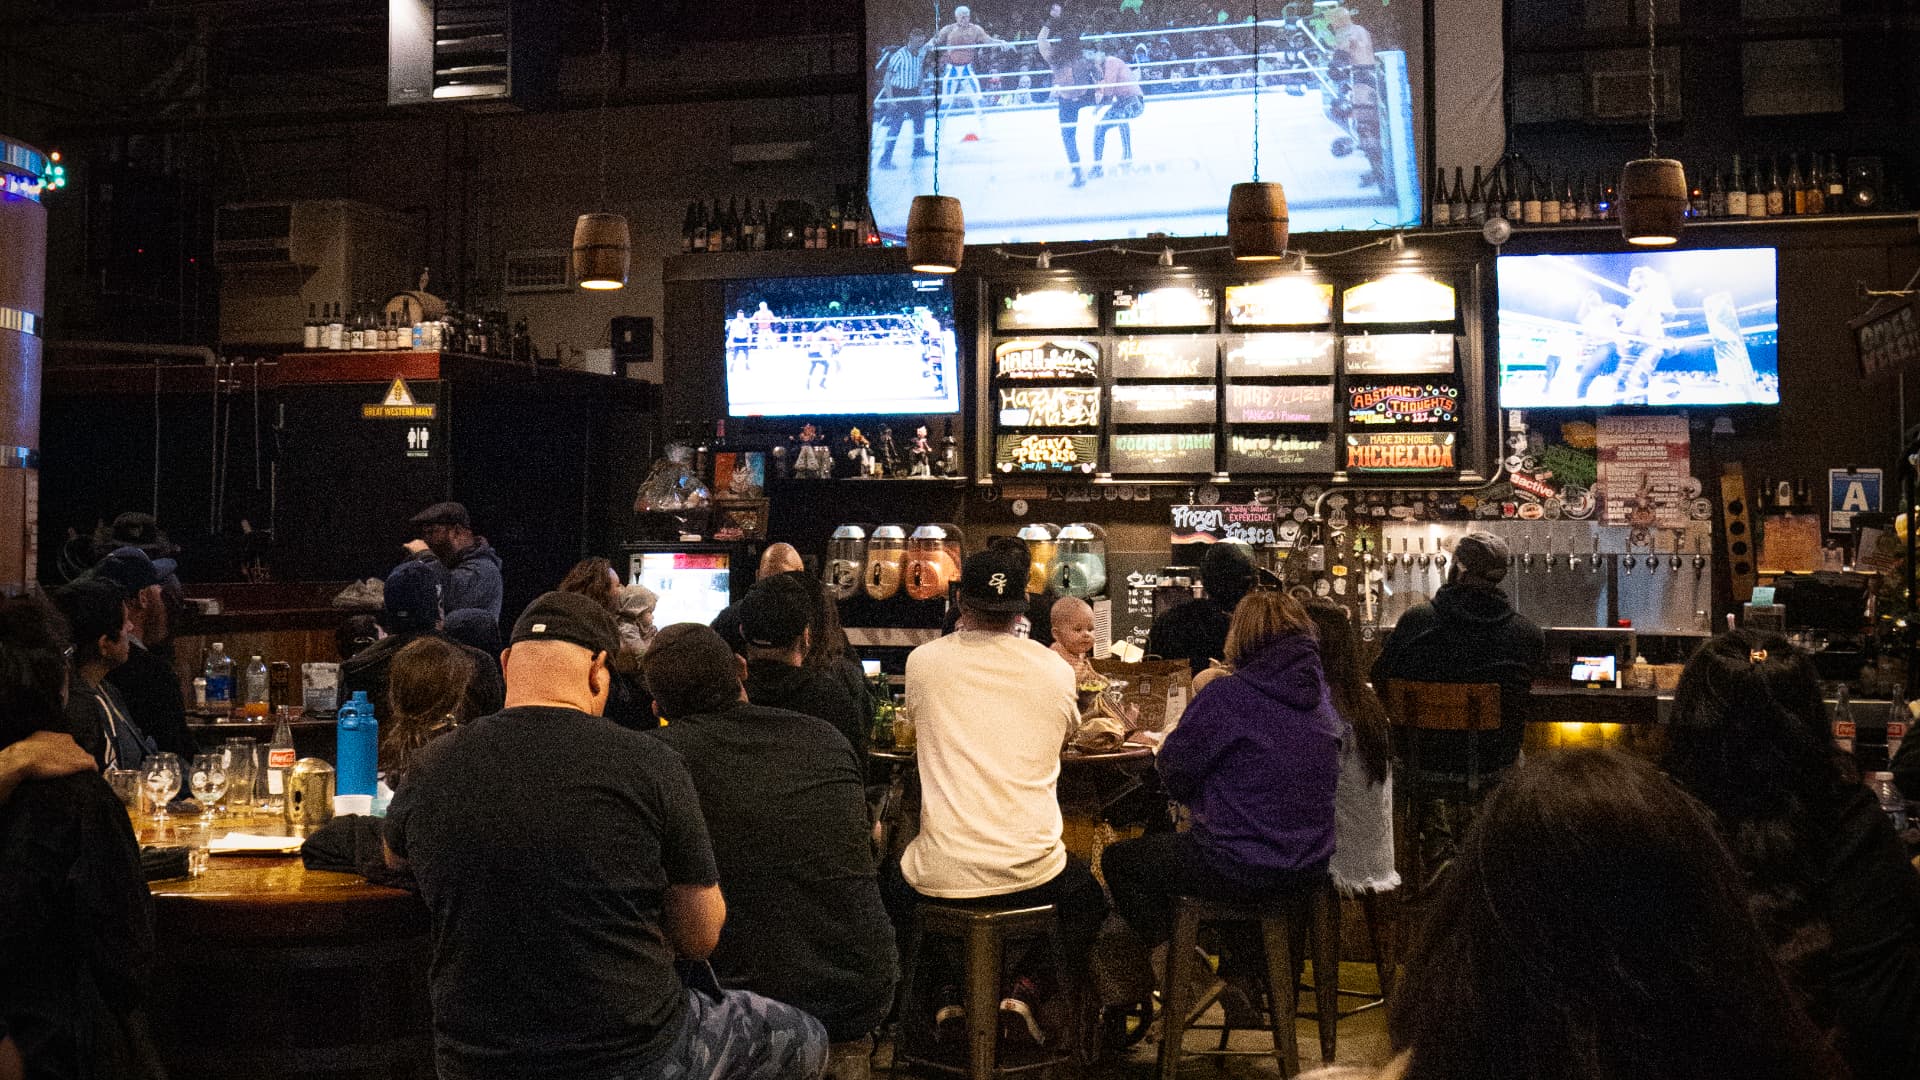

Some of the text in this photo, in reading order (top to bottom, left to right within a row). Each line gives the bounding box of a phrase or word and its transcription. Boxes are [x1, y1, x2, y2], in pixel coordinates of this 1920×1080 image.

[1000, 349, 1043, 371] HARD
[1354, 386, 1421, 406] ABSTRACT
[1391, 397, 1453, 412] THOUGHTS
[364, 407, 433, 416] GREAT WESTERN MALT
[1021, 435, 1074, 449] Guava
[1370, 435, 1434, 444] MADE IN HOUSE
[1012, 447, 1078, 463] Paradise
[1347, 445, 1454, 467] MICHELADA
[1842, 481, 1869, 511] A
[1172, 506, 1224, 531] Frozen
[1229, 513, 1276, 522] EXPERIENCE!
[1223, 522, 1276, 544] Fresca
